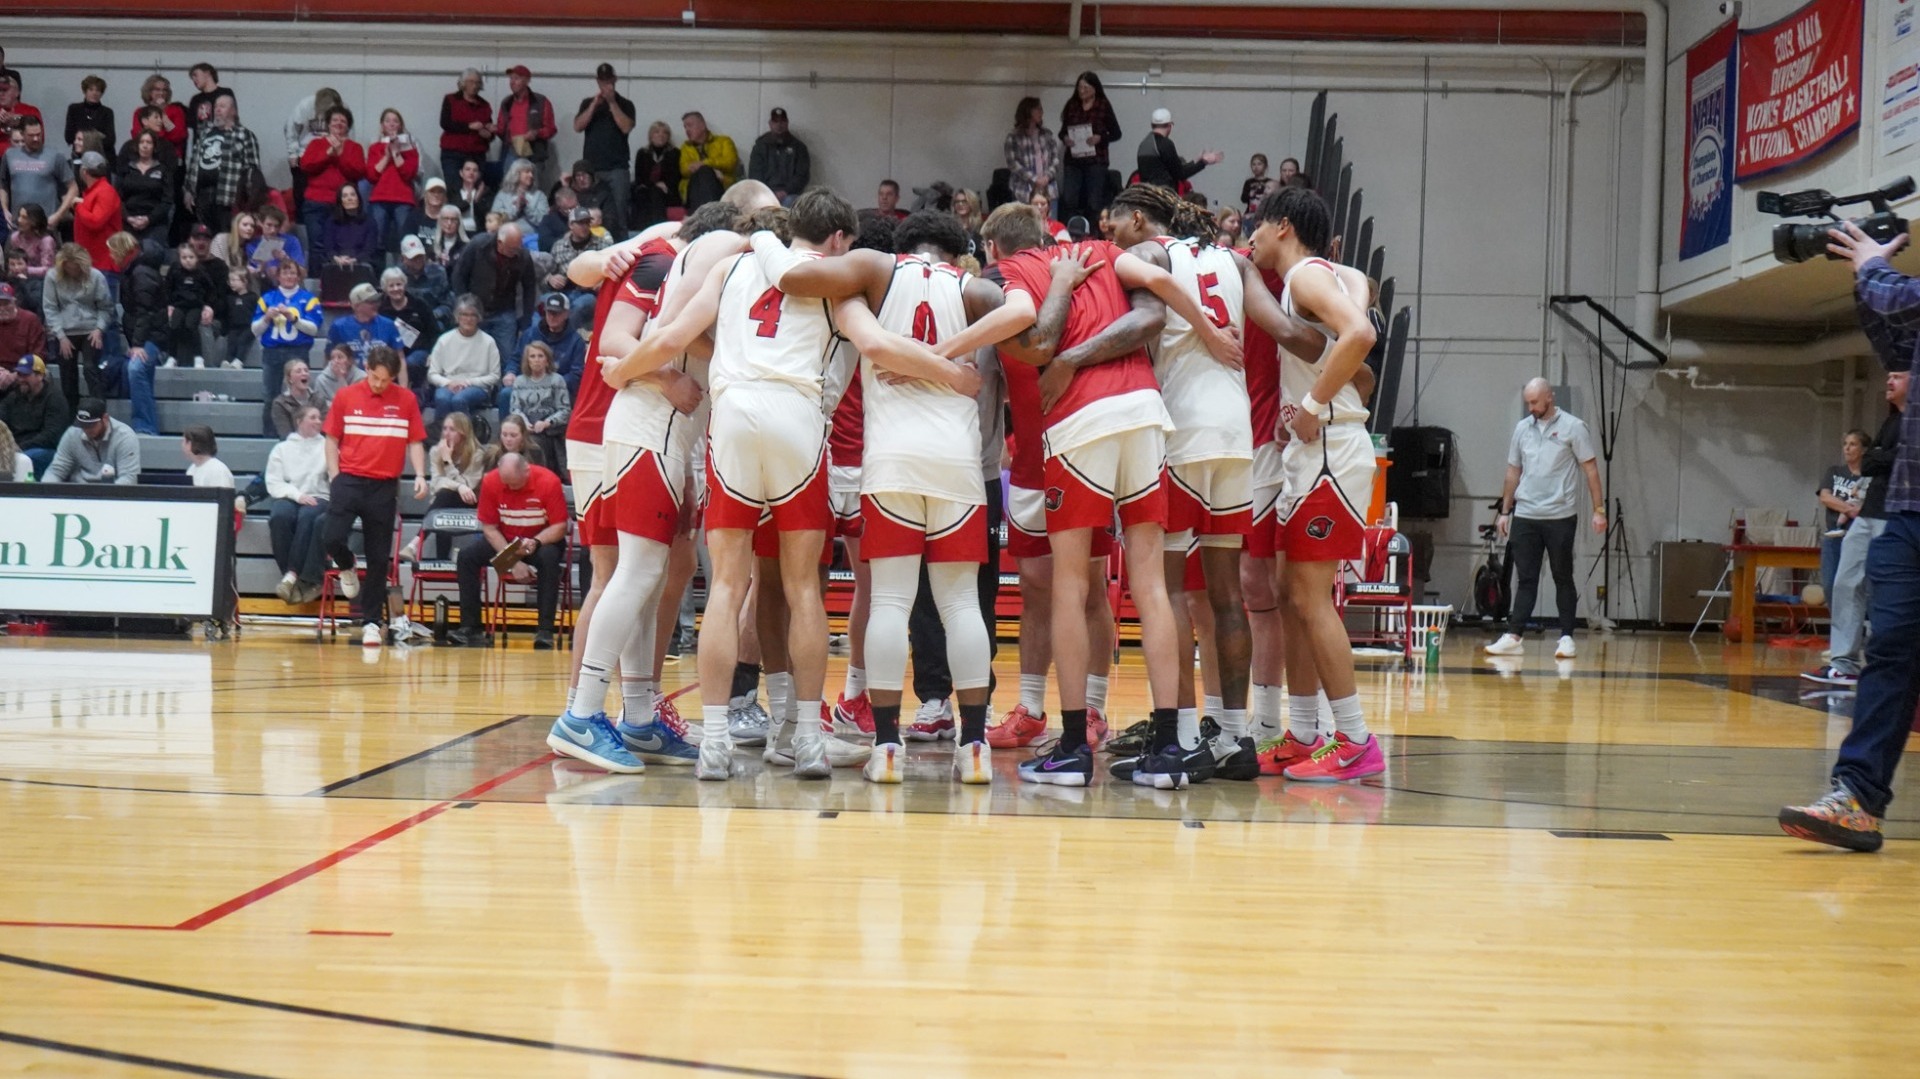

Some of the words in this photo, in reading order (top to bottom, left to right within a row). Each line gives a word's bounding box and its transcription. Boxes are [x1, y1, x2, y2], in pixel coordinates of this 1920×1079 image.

[1774, 28, 1795, 63] 2019
[1770, 51, 1813, 96] DIVISION
[1782, 55, 1848, 122] BASKETBALL
[1750, 128, 1794, 163] NATIONAL
[1793, 93, 1842, 150] CHAMPION
[749, 285, 785, 338] 4
[1196, 272, 1230, 329] 5
[912, 301, 937, 345] 0
[48, 513, 190, 571] Bank
[436, 518, 476, 526] WESTERN
[419, 562, 457, 571] BULLDOG
[829, 572, 856, 580] BULL
[1356, 584, 1400, 593] BULLDOGS
